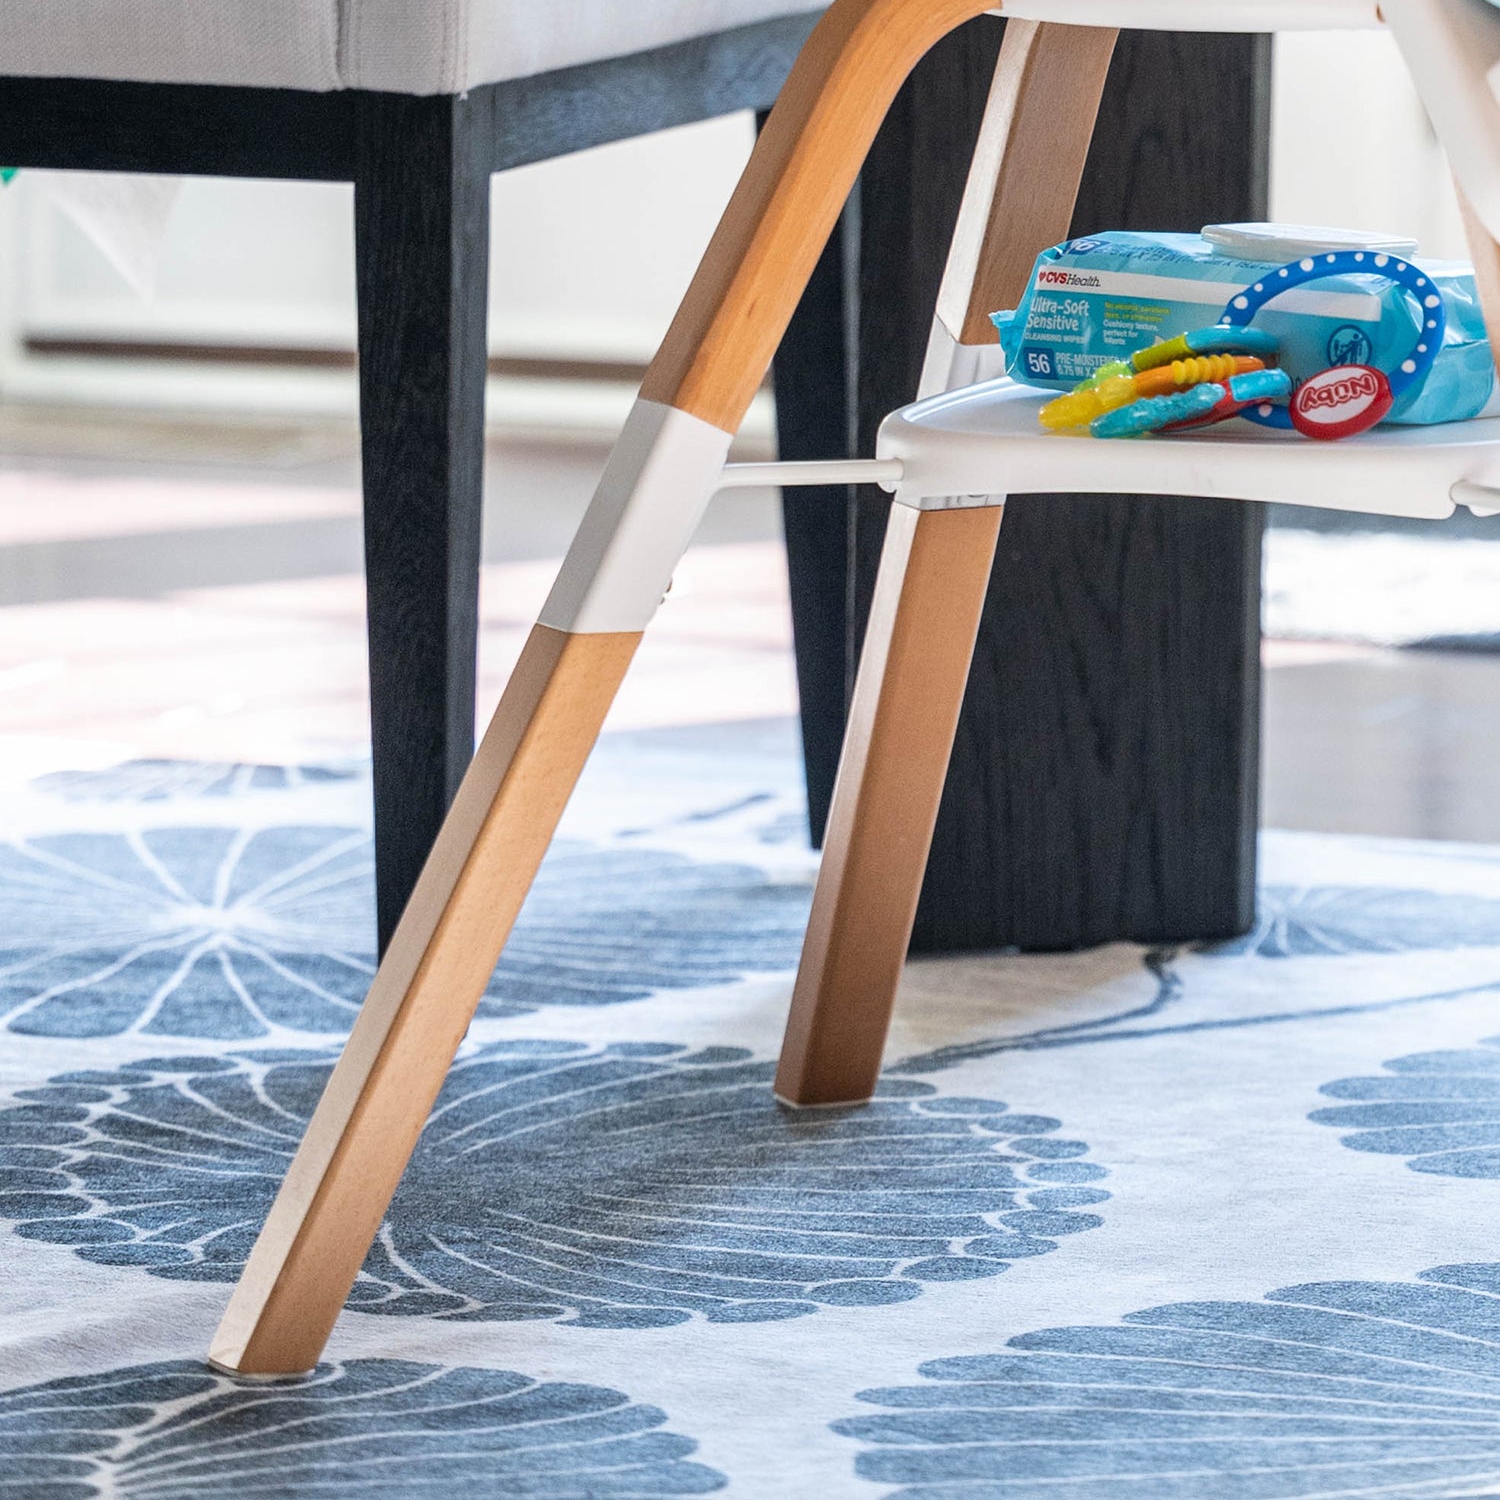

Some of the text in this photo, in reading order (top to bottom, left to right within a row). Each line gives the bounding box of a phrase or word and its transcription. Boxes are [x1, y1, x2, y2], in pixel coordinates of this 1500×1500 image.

[1031, 297, 1089, 316] Ultra-Soft
[1027, 314, 1079, 331] Sensitive
[1028, 353, 1051, 374] 56
